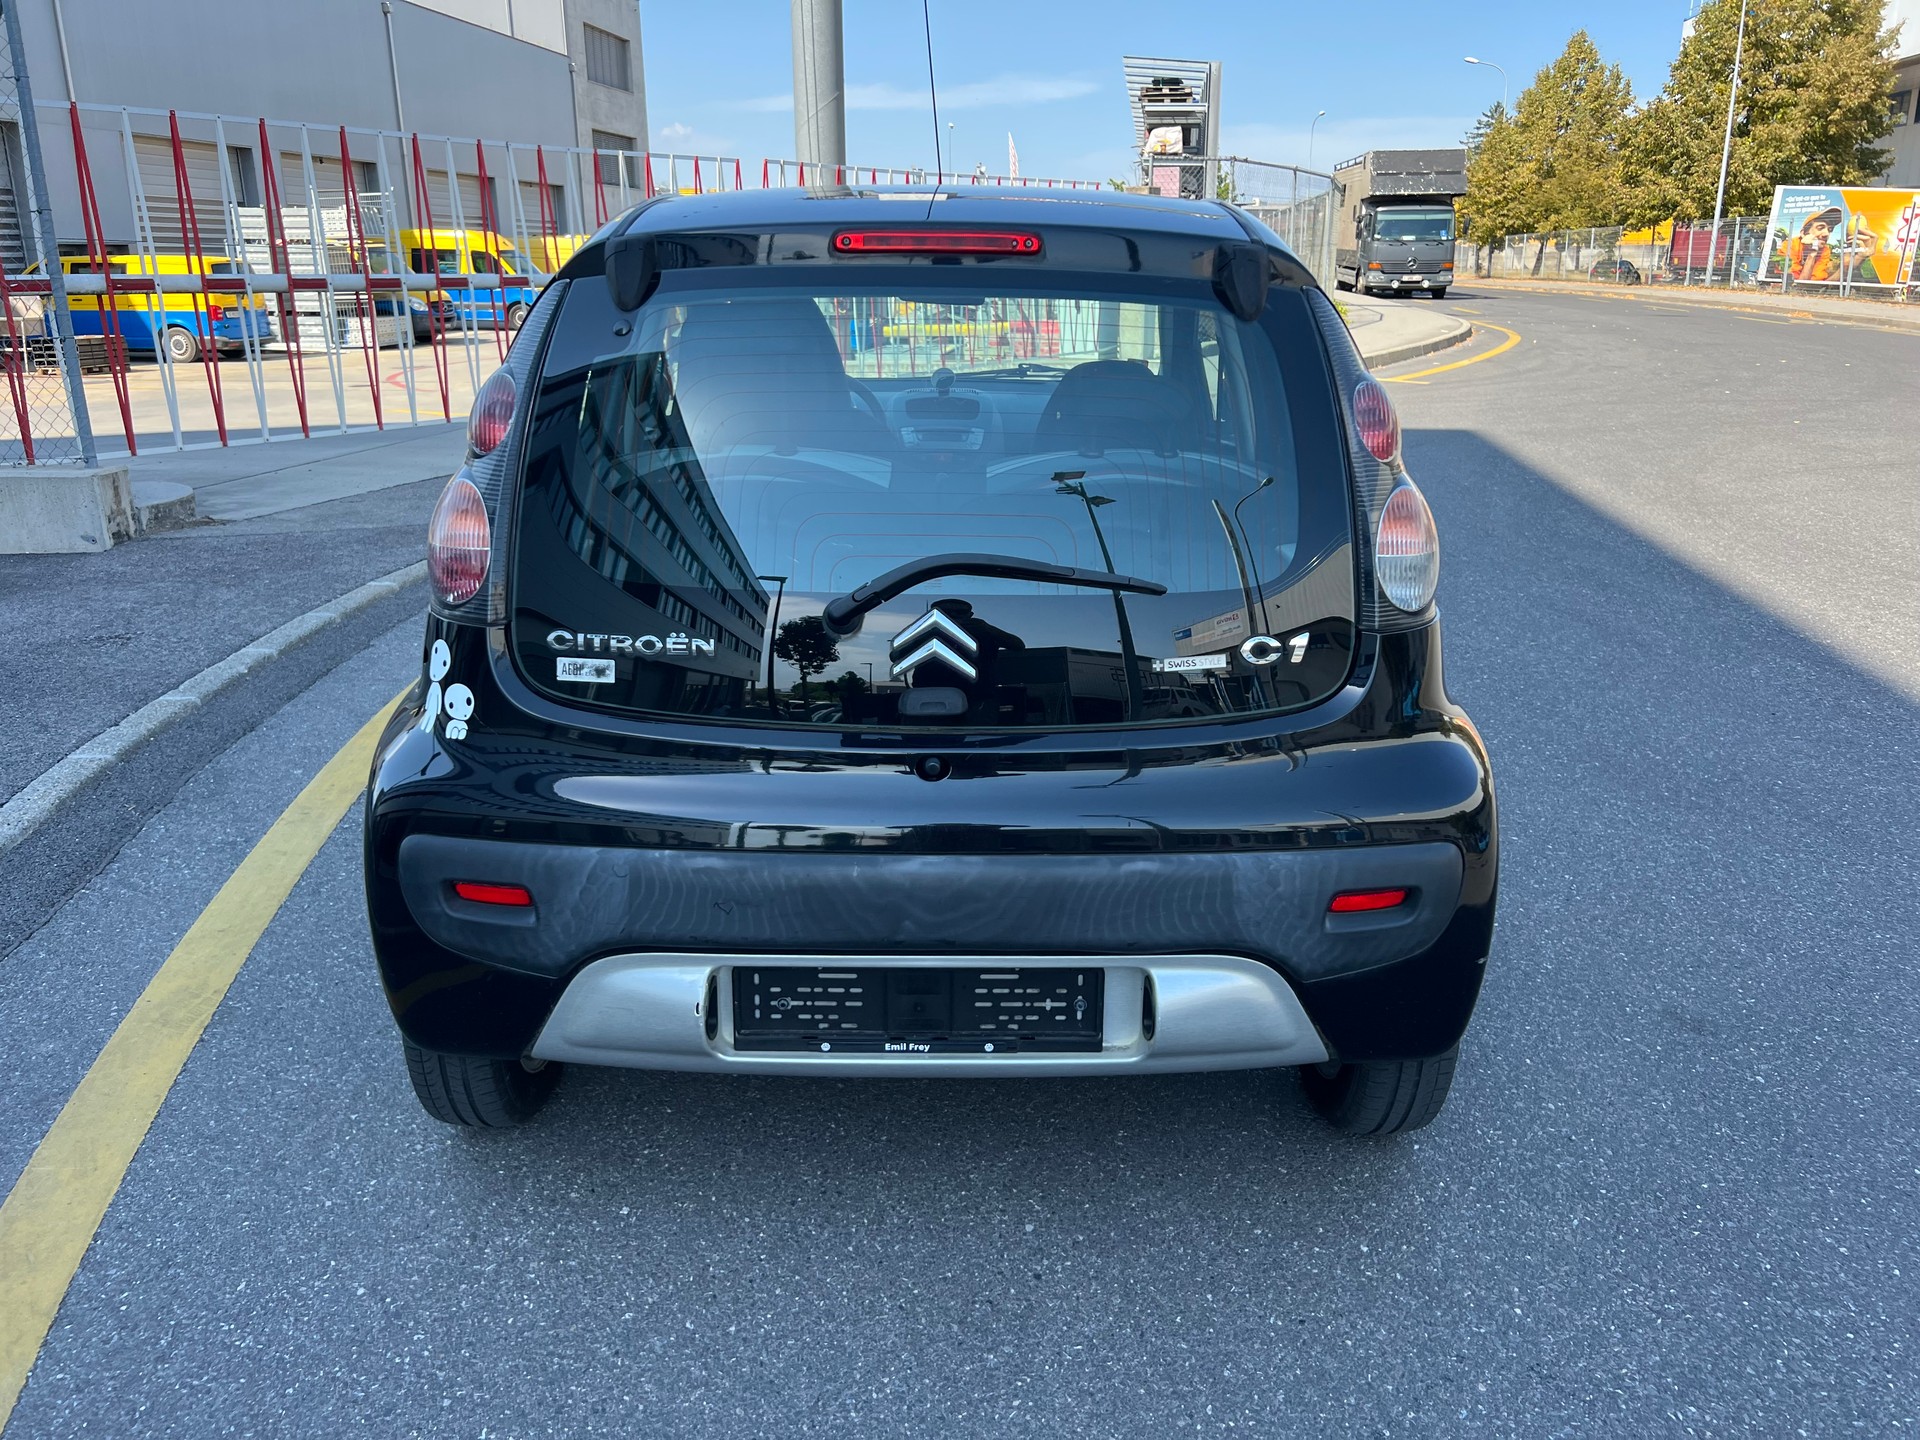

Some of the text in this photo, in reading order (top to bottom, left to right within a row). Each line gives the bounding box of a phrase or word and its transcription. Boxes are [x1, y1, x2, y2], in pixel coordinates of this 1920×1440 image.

[546, 630, 716, 657] CITROËN
[1239, 631, 1310, 666] C1
[1167, 657, 1222, 669] SWISS STYLE
[885, 1042, 931, 1053] Emil Frey
